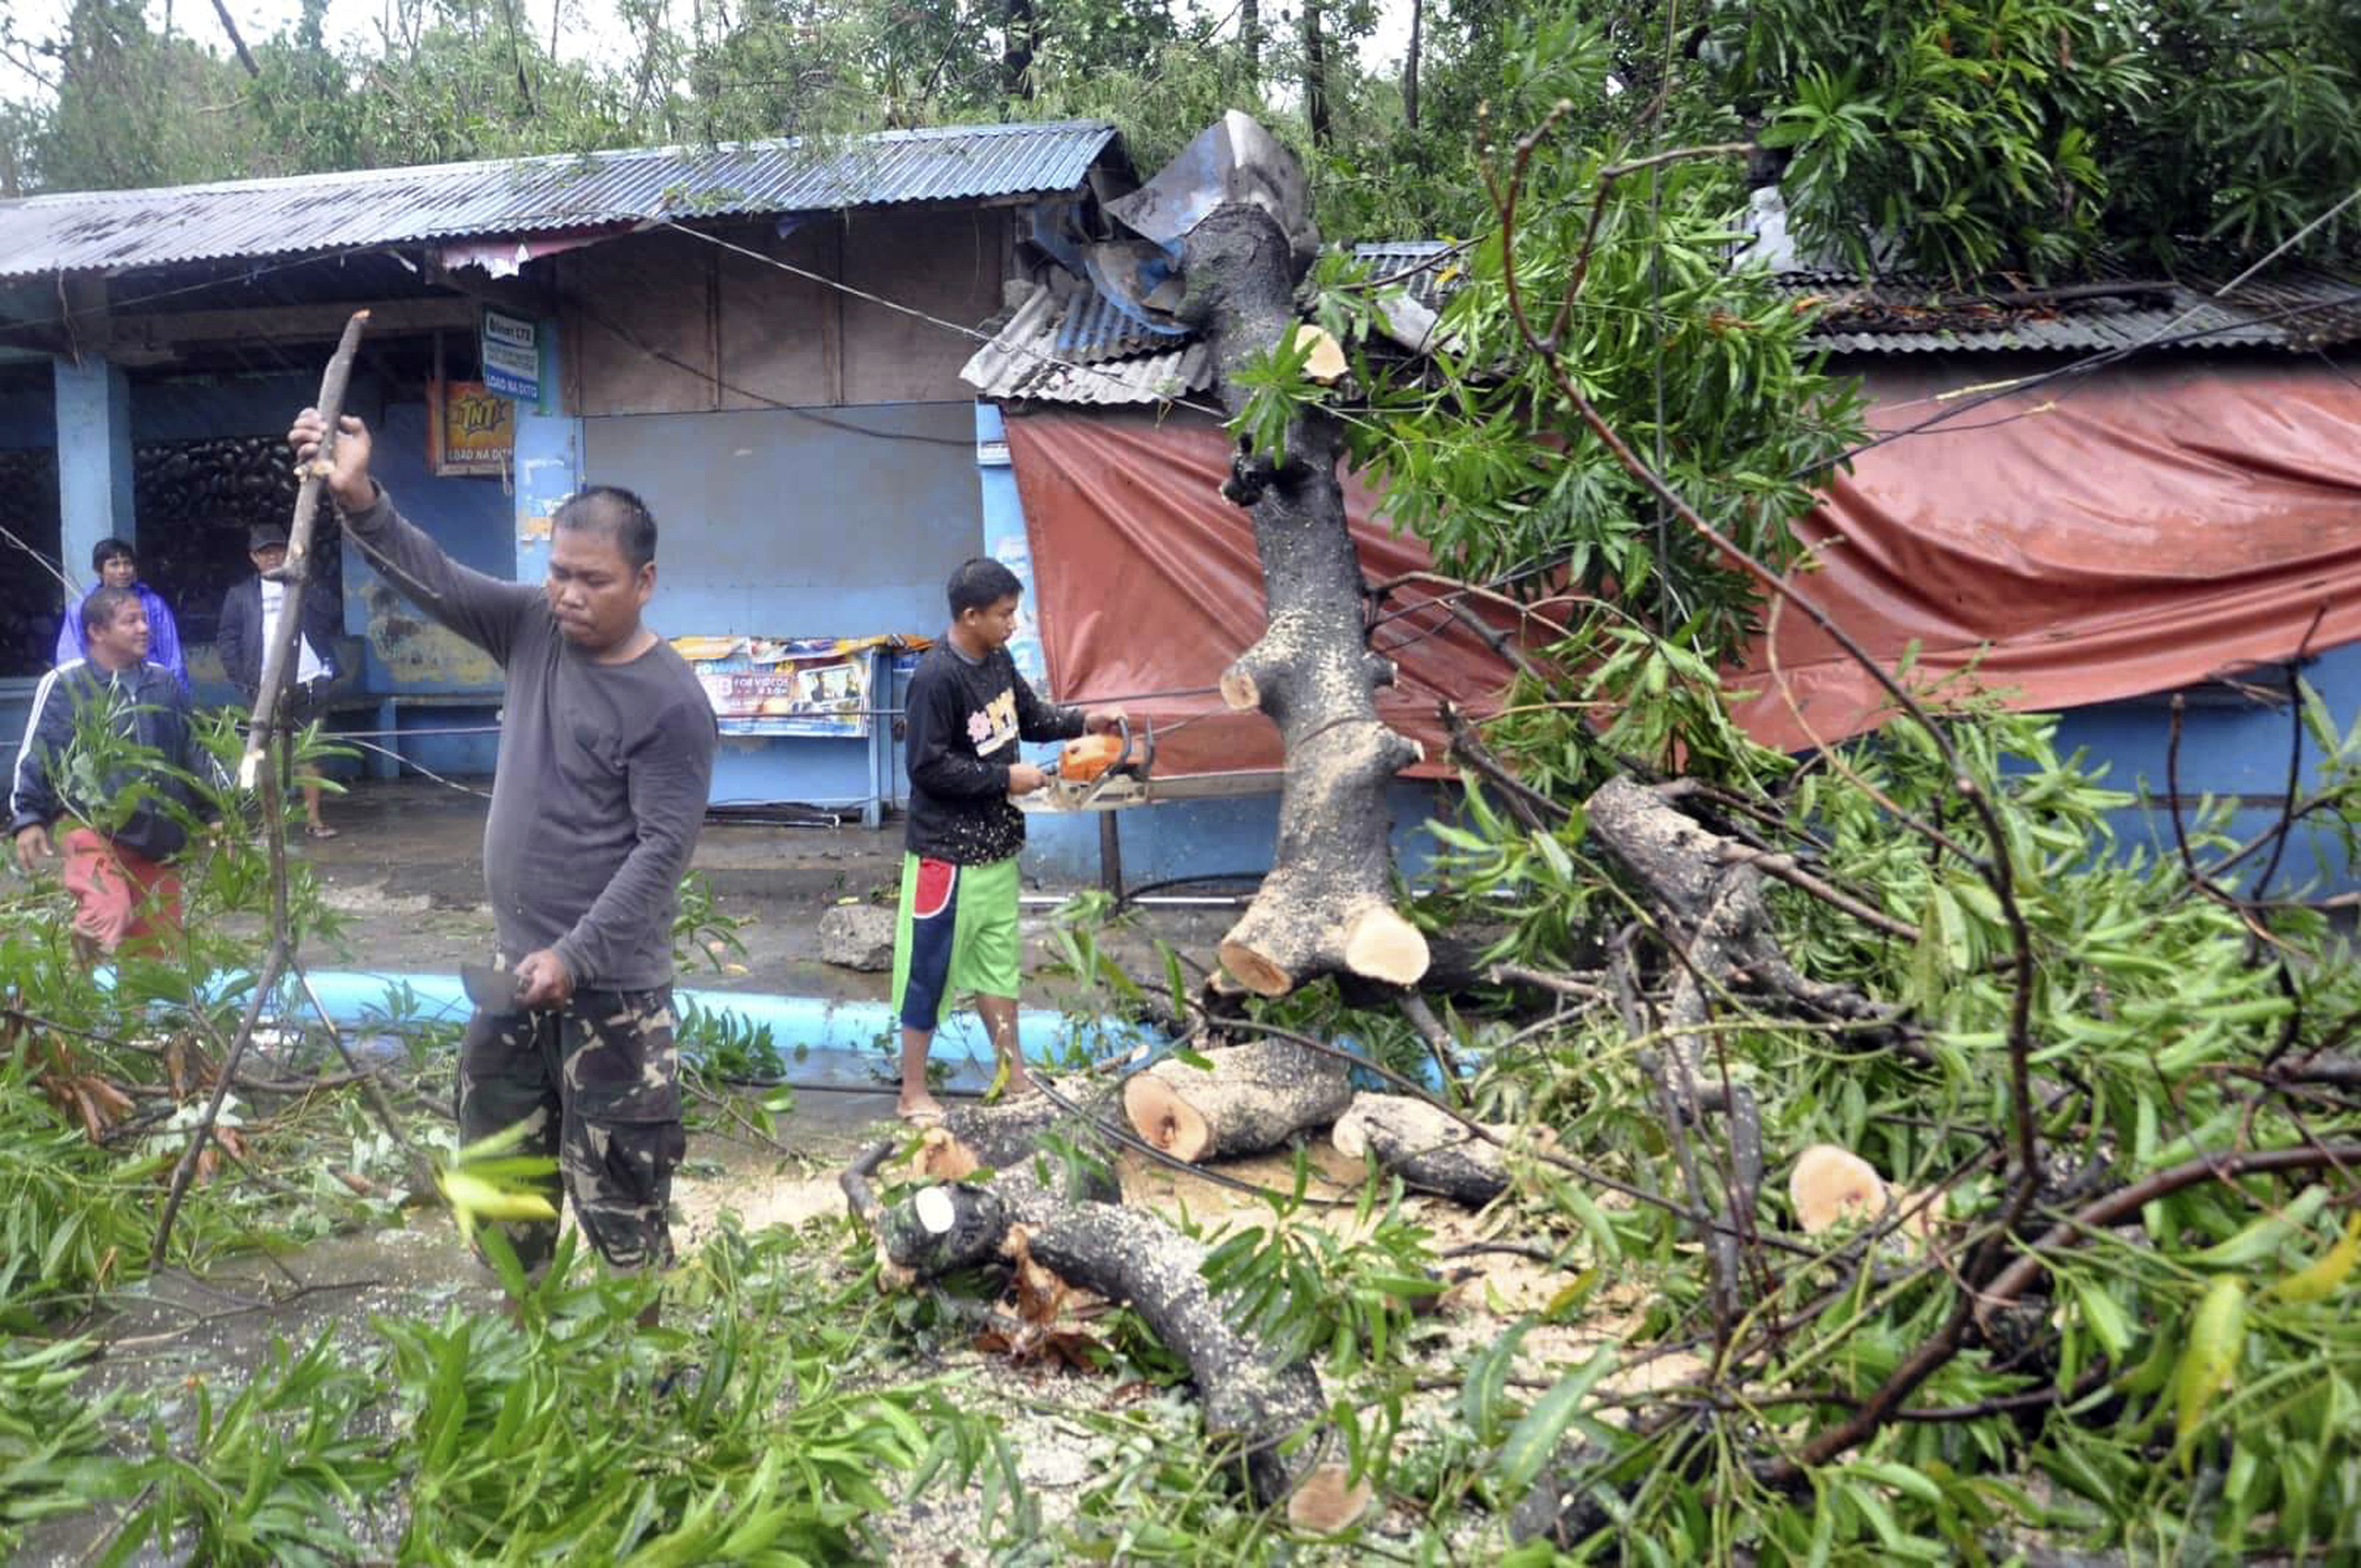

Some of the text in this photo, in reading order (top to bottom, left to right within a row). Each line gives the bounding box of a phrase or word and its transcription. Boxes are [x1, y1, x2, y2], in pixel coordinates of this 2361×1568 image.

[486, 374, 506, 391] LOAD
[508, 378, 517, 393] NA
[458, 397, 495, 430] TNT
[447, 448, 473, 459] LOAD
[476, 448, 493, 459] NA
